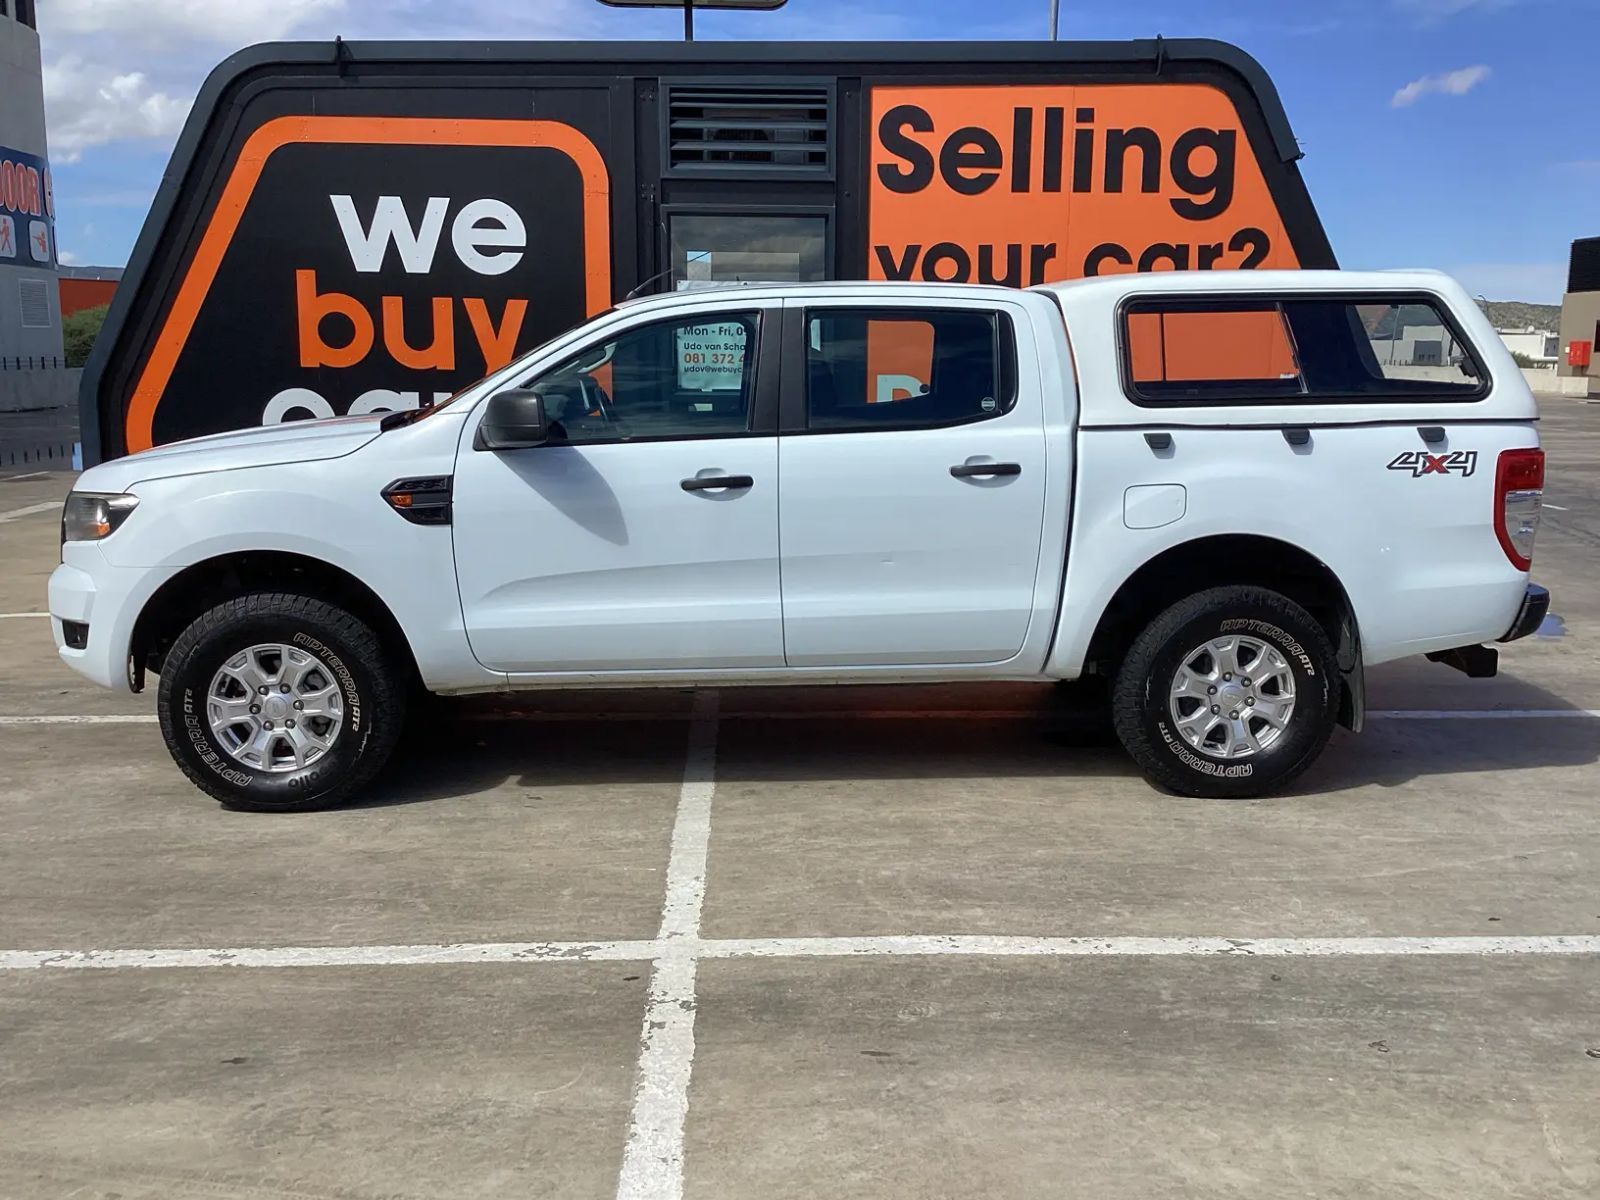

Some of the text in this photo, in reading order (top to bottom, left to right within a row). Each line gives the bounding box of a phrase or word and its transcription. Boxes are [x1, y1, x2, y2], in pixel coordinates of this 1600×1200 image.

[0, 159, 42, 217] OOR
[877, 104, 1236, 221] Selling
[330, 194, 527, 275] we
[875, 227, 1271, 288] your car?
[296, 269, 528, 375] buy
[684, 326, 708, 336] Mon
[719, 326, 734, 337] Fri,
[736, 327, 747, 336] 0
[684, 343, 702, 351] Udo
[684, 352, 706, 364] 081
[711, 353, 735, 364] 372
[1385, 450, 1478, 478] 4x4
[1220, 618, 1302, 657] APTERRA
[293, 632, 360, 708] APTERRA
